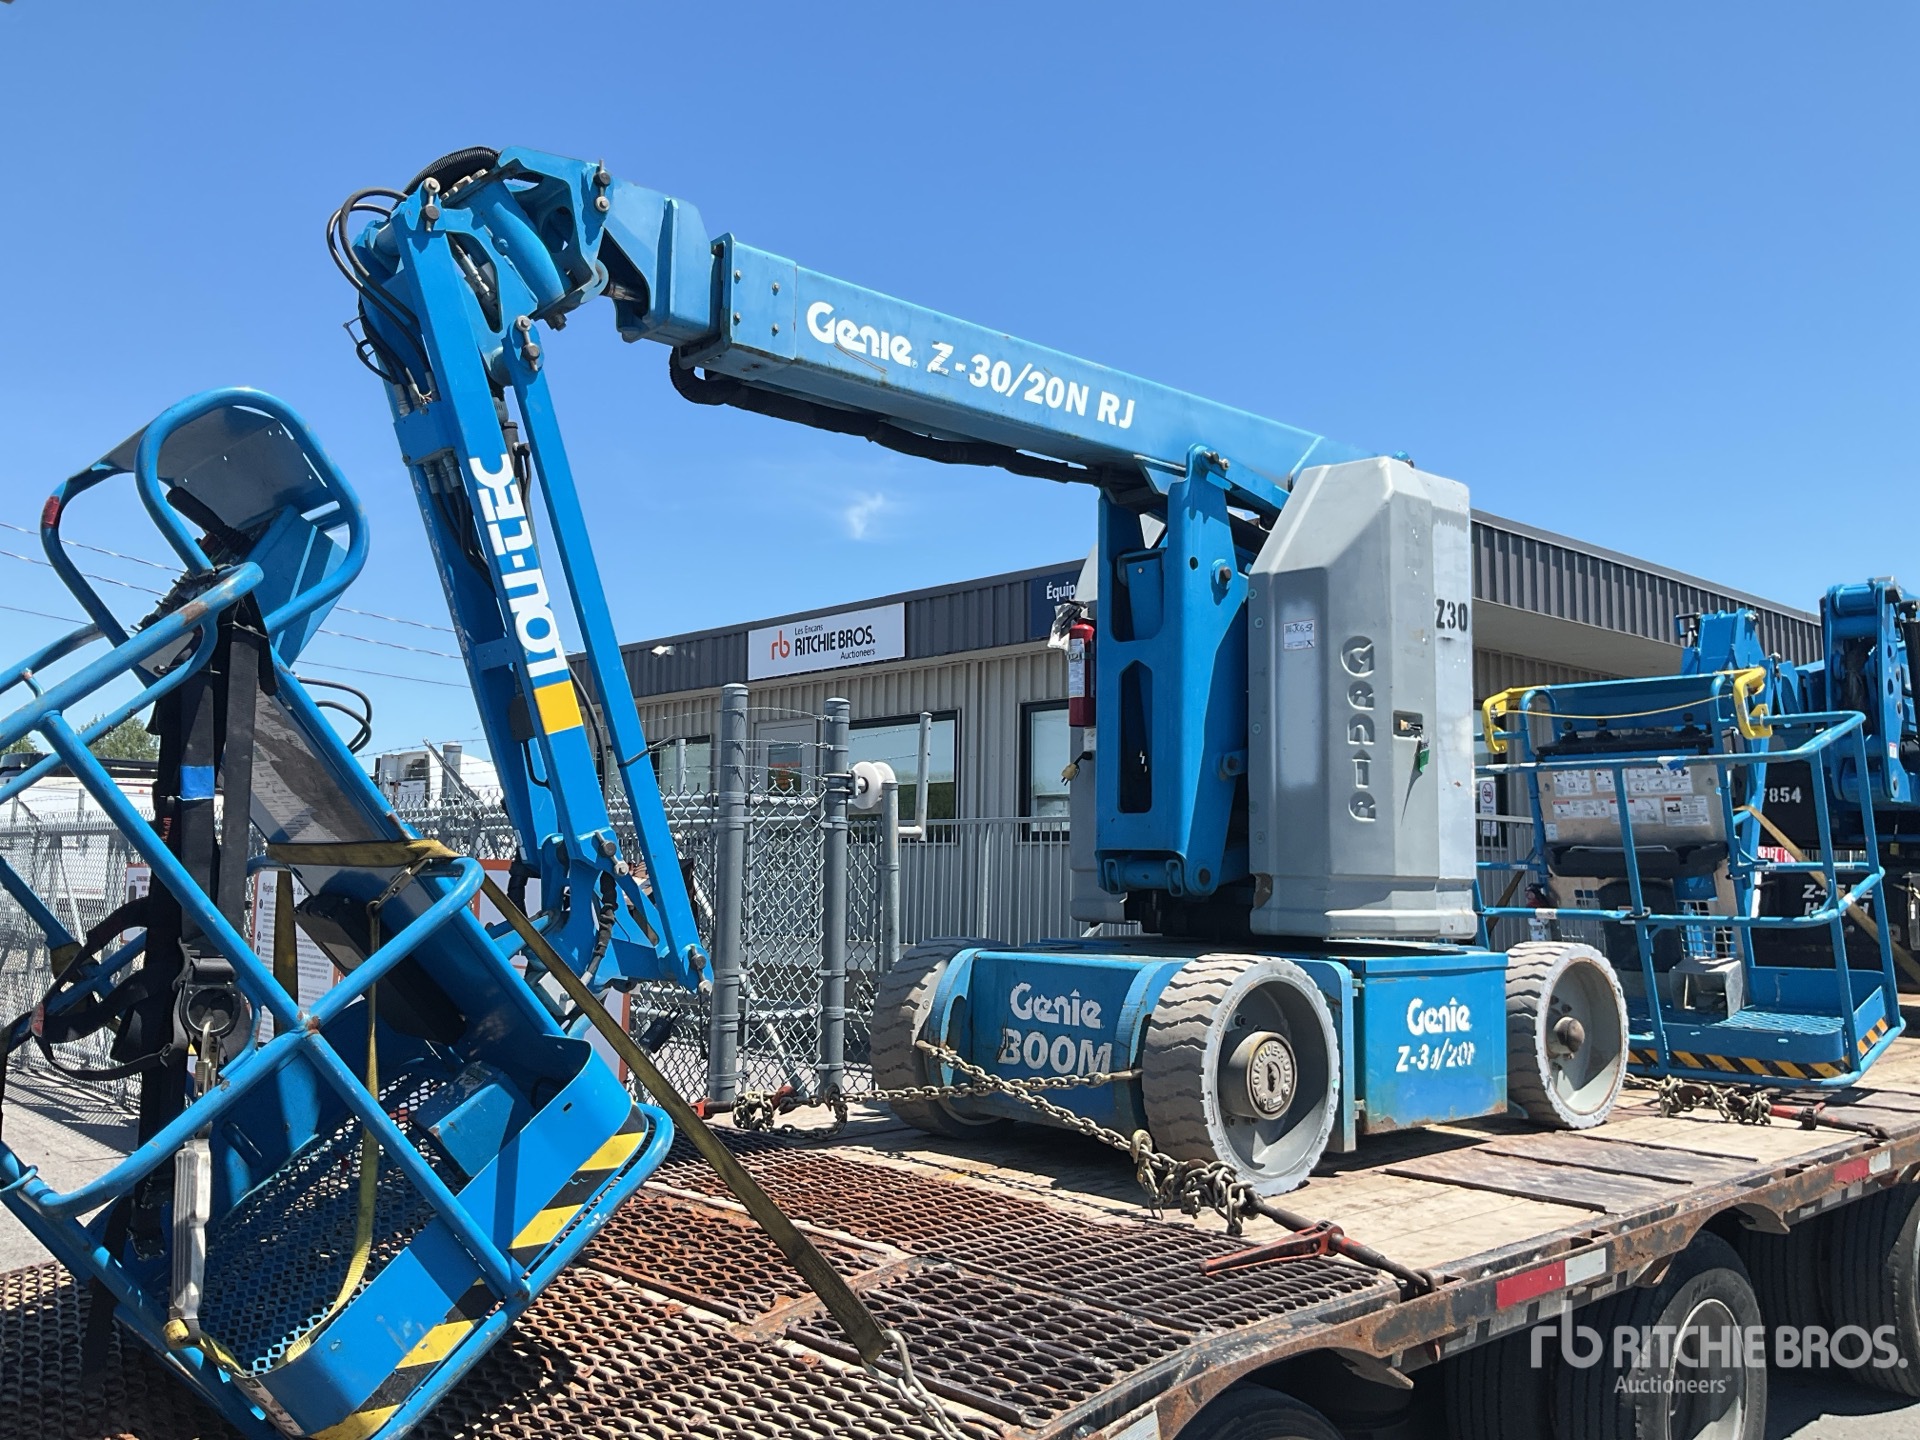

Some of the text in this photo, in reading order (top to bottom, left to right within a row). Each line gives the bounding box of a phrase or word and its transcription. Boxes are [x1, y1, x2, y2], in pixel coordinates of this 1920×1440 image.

[806, 301, 1136, 430] Genie Z-30/20N RJ
[794, 624, 824, 636] Les Encans
[1436, 598, 1468, 632] Z30
[794, 625, 876, 657] RITCHIE BROS.
[840, 647, 876, 660] Auctioneers
[1764, 786, 1801, 803] 854
[1010, 982, 1102, 1029] Genie
[1407, 996, 1471, 1036] Genie
[998, 1028, 1112, 1076] BOOM
